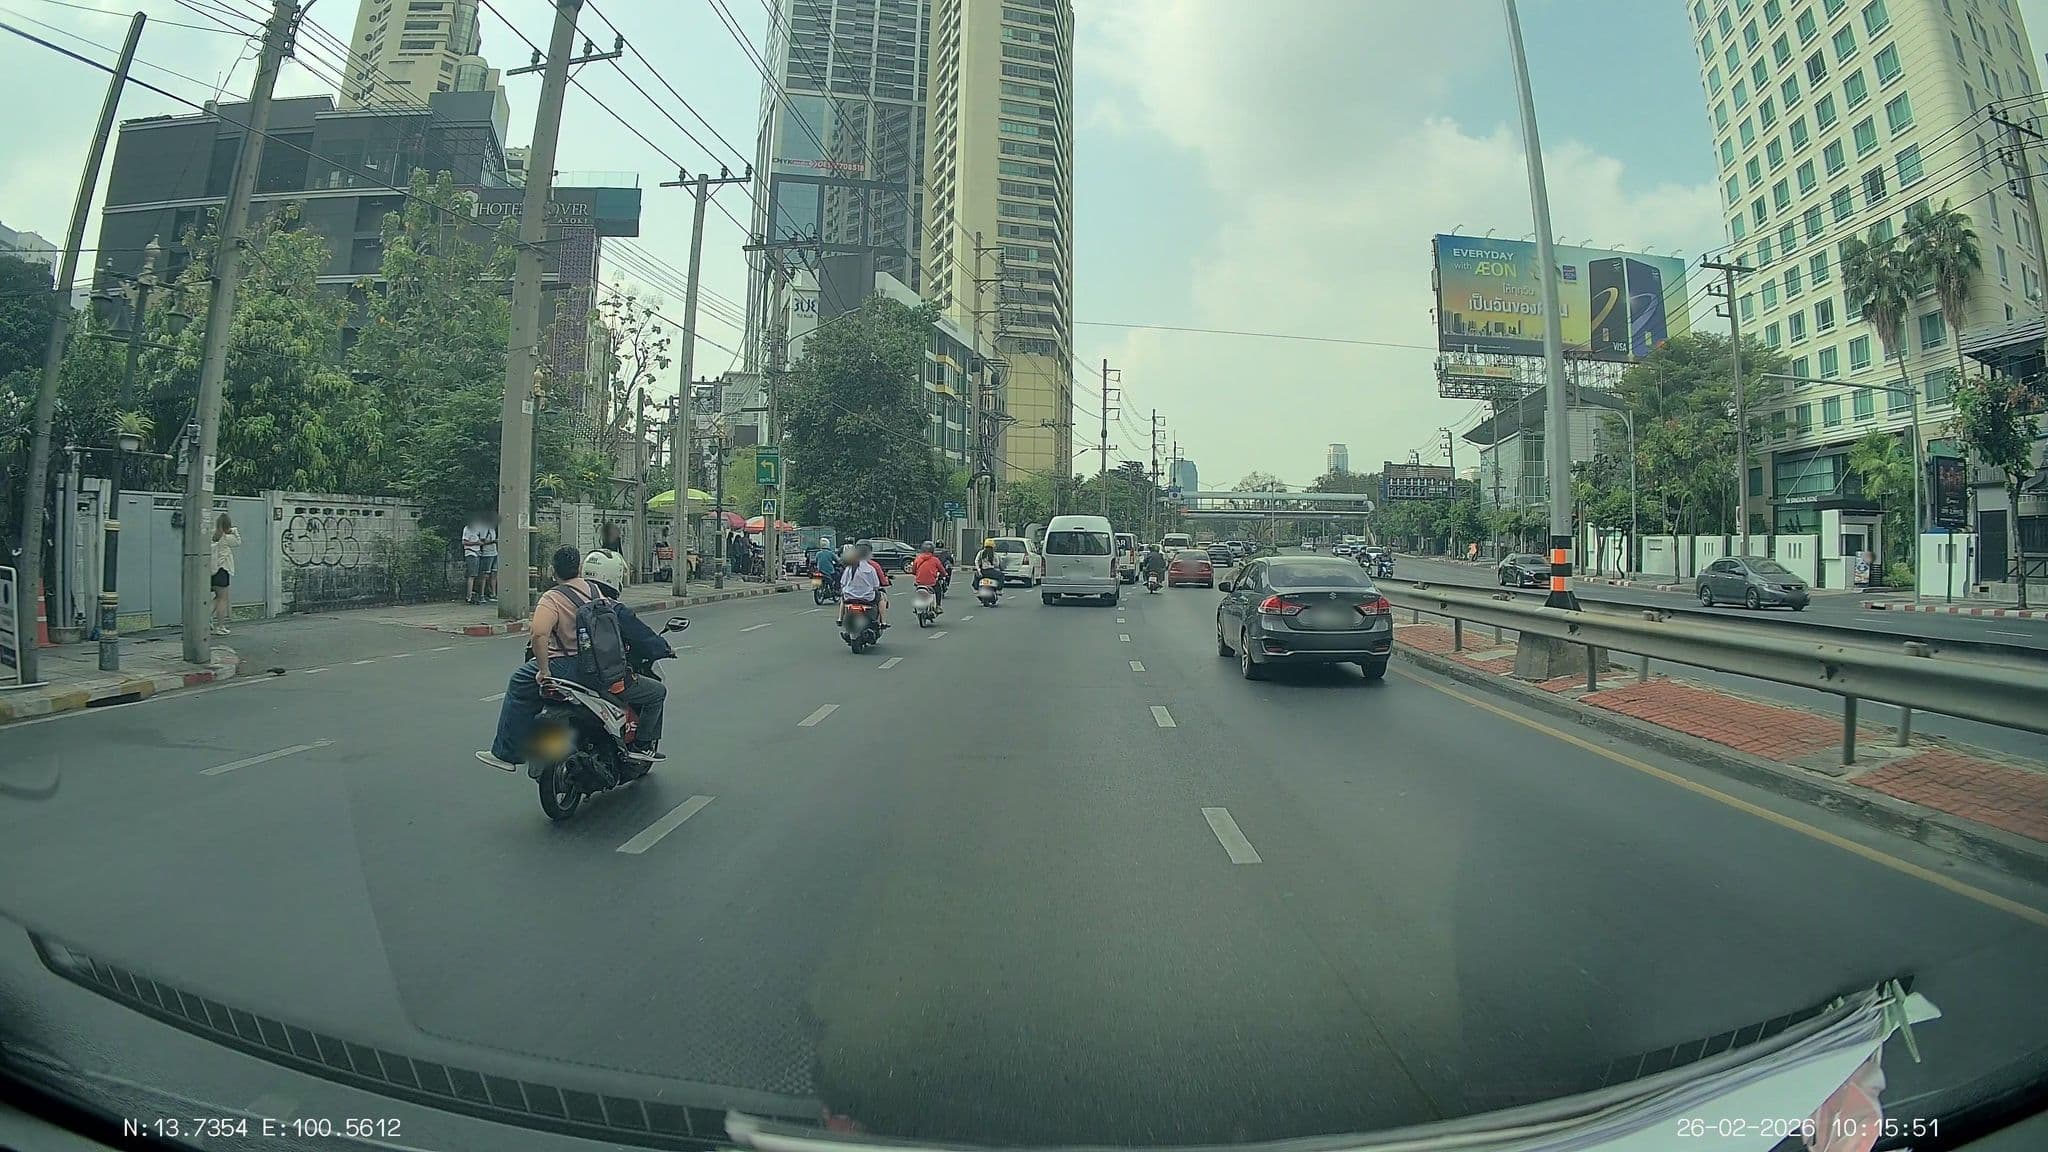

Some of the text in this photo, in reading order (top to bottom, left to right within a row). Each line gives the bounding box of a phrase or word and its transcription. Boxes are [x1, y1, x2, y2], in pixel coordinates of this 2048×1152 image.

[1453, 248, 1514, 261] EVERYDAY
[1454, 261, 1472, 270] with
[1612, 341, 1627, 352] VISA
